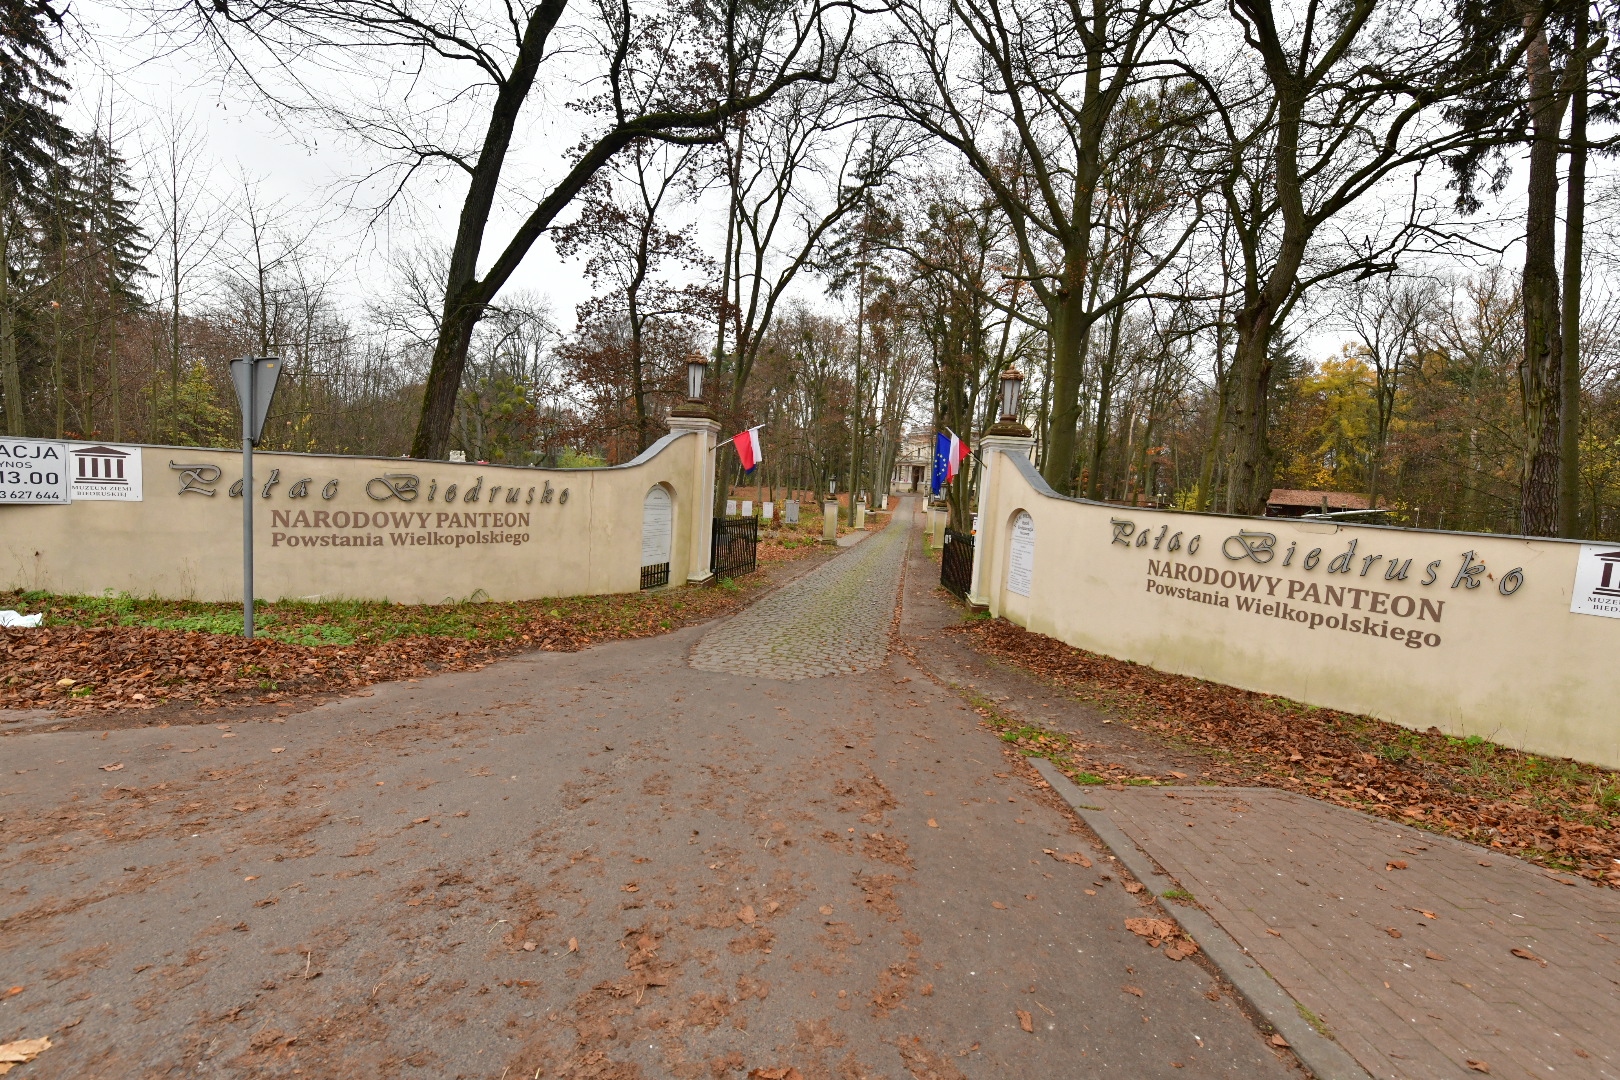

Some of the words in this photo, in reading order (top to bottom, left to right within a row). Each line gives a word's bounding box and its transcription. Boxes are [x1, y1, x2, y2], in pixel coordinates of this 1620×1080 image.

[0, 444, 59, 460] ACJA
[0, 471, 59, 485] 13.00
[10, 491, 32, 499] 627
[35, 491, 59, 500] 644
[365, 472, 570, 505] Biedrusko
[271, 509, 431, 529] NARODOWY
[435, 512, 531, 528] PANTEON
[271, 532, 384, 547] Powstania
[389, 530, 530, 548] Wielkopolskiego
[1110, 517, 1202, 555] Pałac
[1221, 529, 1525, 597] Biedrusko
[1147, 559, 1283, 597] NARODOWY
[1287, 580, 1446, 623] PANTEON
[1587, 596, 1620, 605] MUZE
[1145, 579, 1230, 608] Powstania
[1235, 595, 1442, 649] Wielkopolskiego
